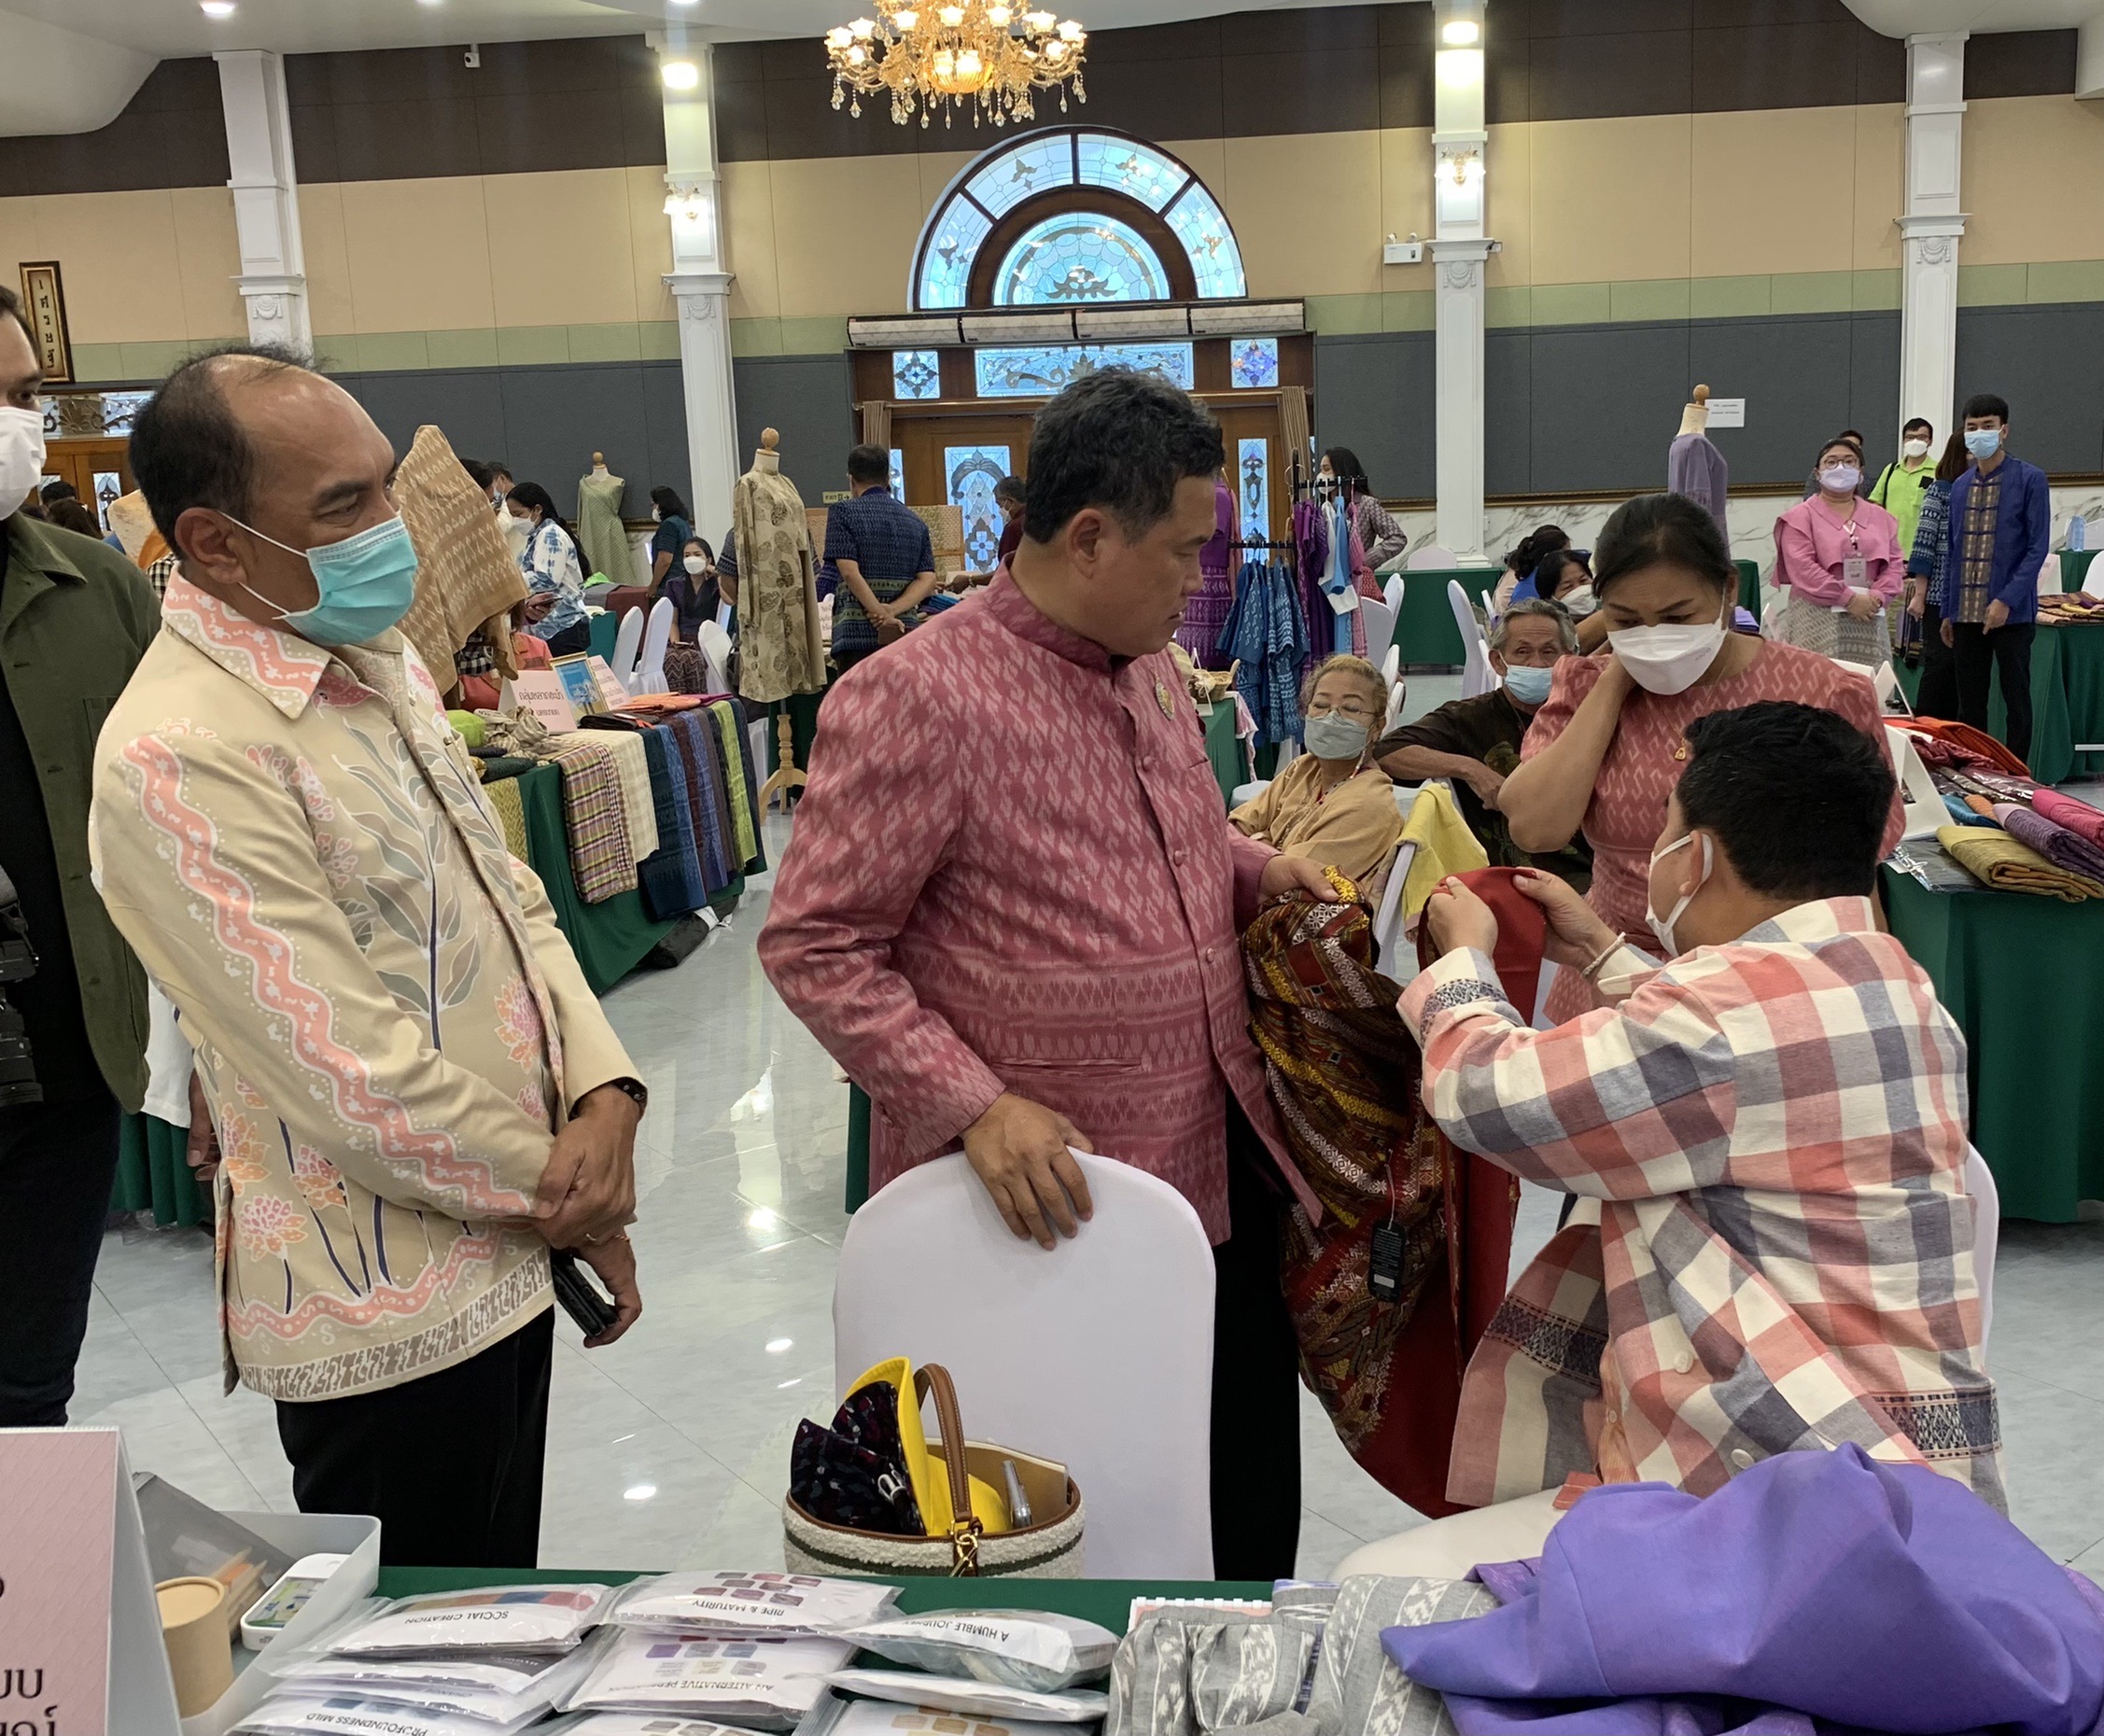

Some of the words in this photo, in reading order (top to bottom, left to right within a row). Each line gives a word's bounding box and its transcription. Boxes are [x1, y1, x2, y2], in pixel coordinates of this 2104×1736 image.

[693, 1599, 747, 1612] MATURITY
[750, 1605, 758, 1614] &
[467, 1610, 510, 1620] SOCIAL
[760, 1607, 785, 1617] RIPE
[404, 1613, 463, 1624] CREATION
[954, 1622, 999, 1640] HUMBLE
[1001, 1631, 1010, 1642] A
[680, 1680, 754, 1691] ALTERNATIVE
[755, 1683, 775, 1691] AN
[305, 1712, 335, 1724] MILD
[335, 1715, 428, 1736] PROFOUNDNESS
